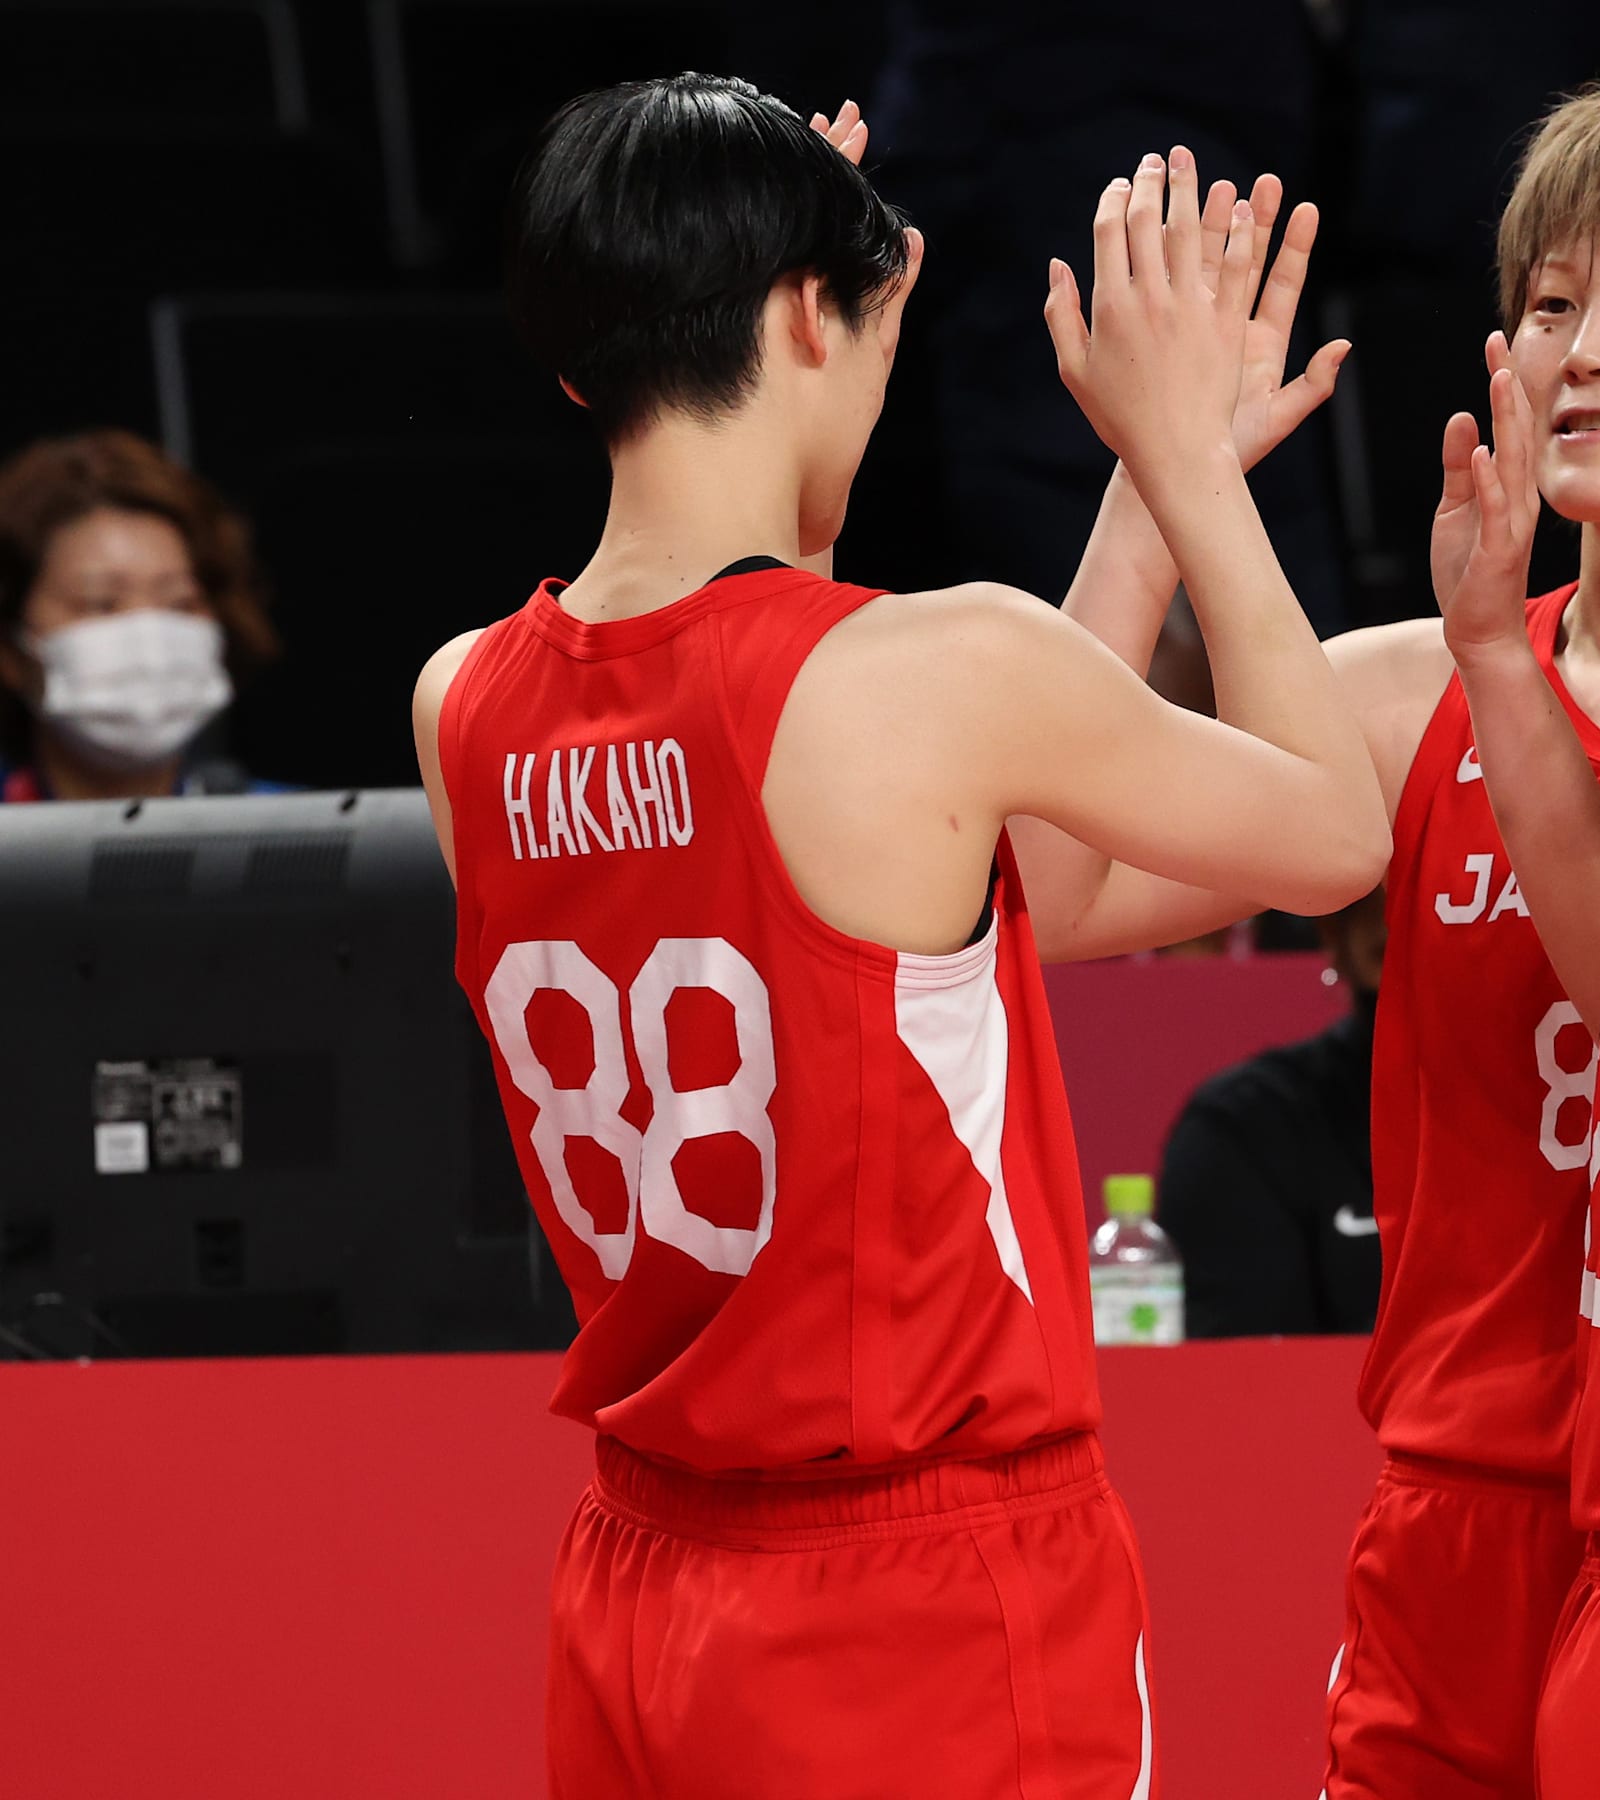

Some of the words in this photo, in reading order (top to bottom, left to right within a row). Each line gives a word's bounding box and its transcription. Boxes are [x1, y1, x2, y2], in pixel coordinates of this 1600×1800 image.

[503, 738, 694, 860] H.AKAHO
[484, 937, 777, 1281] 88
[1534, 1000, 1600, 1172] 8
